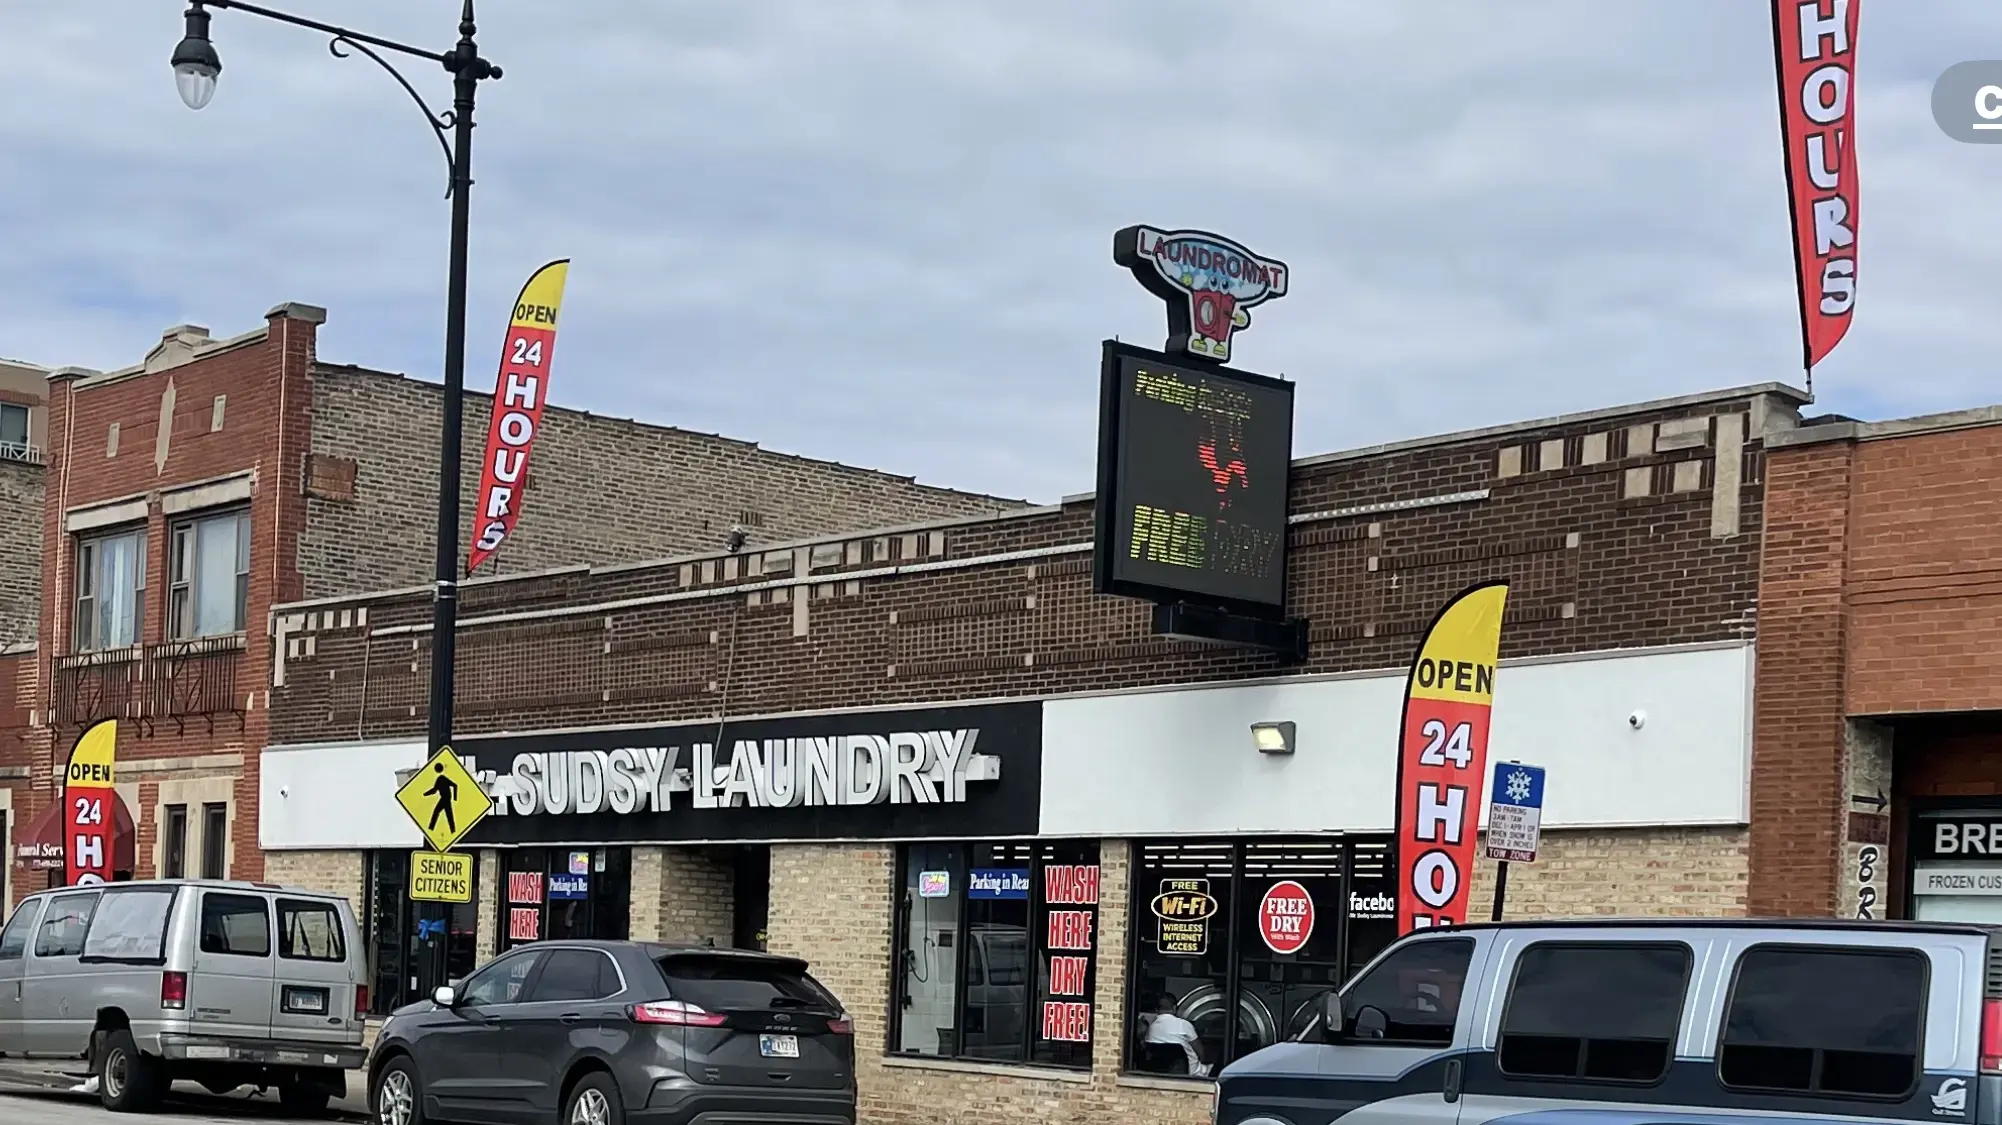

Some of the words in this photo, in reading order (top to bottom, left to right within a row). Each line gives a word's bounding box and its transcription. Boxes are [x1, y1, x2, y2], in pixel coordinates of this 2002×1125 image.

[1798, 0, 1856, 316] HOURS
[1139, 231, 1283, 290] LAUNDROMAT
[515, 303, 557, 325] OPEN
[511, 336, 543, 367] 24
[476, 373, 539, 551] HOURS
[1417, 657, 1493, 694] OPEN
[1419, 718, 1474, 770] 24
[70, 763, 111, 782] OPEN
[511, 746, 680, 817] SUDSY
[692, 728, 980, 810] LAUNDRY
[75, 796, 102, 825] 24
[1934, 822, 2002, 855] BRE
[420, 858, 463, 876] SENIOR
[1411, 782, 1468, 930] HO
[1489, 848, 1508, 858] TOW
[1510, 851, 1533, 861] ZONE
[415, 877, 467, 894] CITIZENS
[508, 871, 544, 904] WASH
[970, 872, 1001, 896] Parking
[1001, 872, 1011, 890] in
[1044, 865, 1100, 904] WASH
[1171, 881, 1199, 891] FREE
[1928, 874, 1975, 889] FROZEN
[1977, 874, 2002, 889] CUS
[1266, 897, 1308, 916] FREE
[509, 907, 540, 940] HERE
[1047, 911, 1093, 950] HERE
[1162, 923, 1204, 933] WIRELESS
[1162, 932, 1203, 942] INTERNET
[1269, 915, 1303, 933] DRY
[1166, 942, 1198, 951] ACCESS
[1050, 956, 1089, 996] DRY
[1042, 1001, 1091, 1042] FREE!
